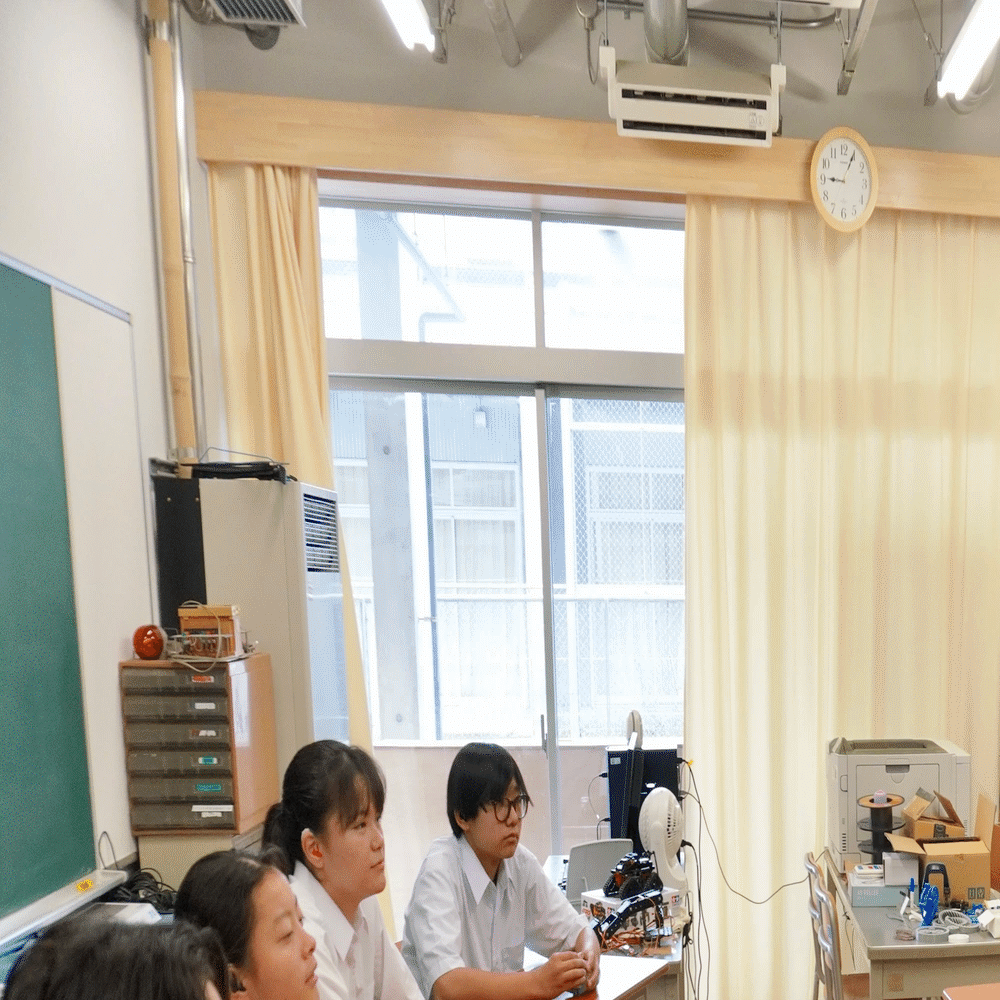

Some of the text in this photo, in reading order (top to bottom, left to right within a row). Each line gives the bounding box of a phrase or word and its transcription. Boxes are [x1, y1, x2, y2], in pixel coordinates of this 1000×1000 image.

[830, 147, 837, 159] 11
[840, 143, 849, 156] 12
[822, 158, 830, 170] 10
[859, 162, 865, 174] 2
[820, 173, 826, 185] 9
[861, 178, 868, 190] 3
[822, 189, 829, 202] 8
[830, 202, 836, 214] 7
[840, 207, 847, 219] 6
[851, 204, 857, 216] 5
